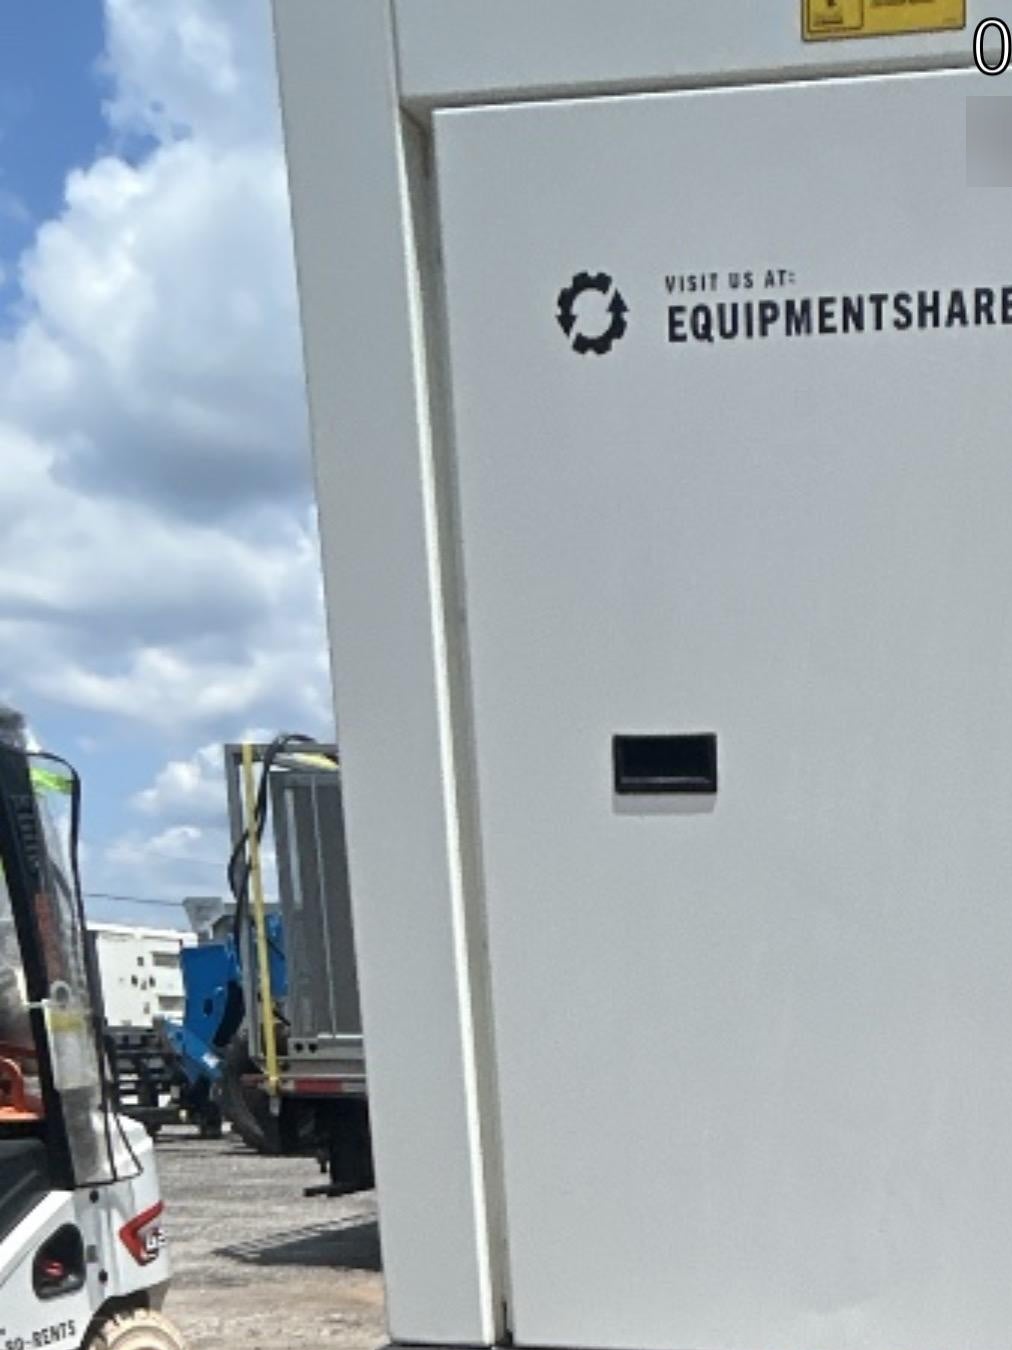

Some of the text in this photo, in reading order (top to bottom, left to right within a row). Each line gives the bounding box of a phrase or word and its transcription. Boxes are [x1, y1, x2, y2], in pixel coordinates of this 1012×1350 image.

[665, 269, 796, 294] VISIT US AT:
